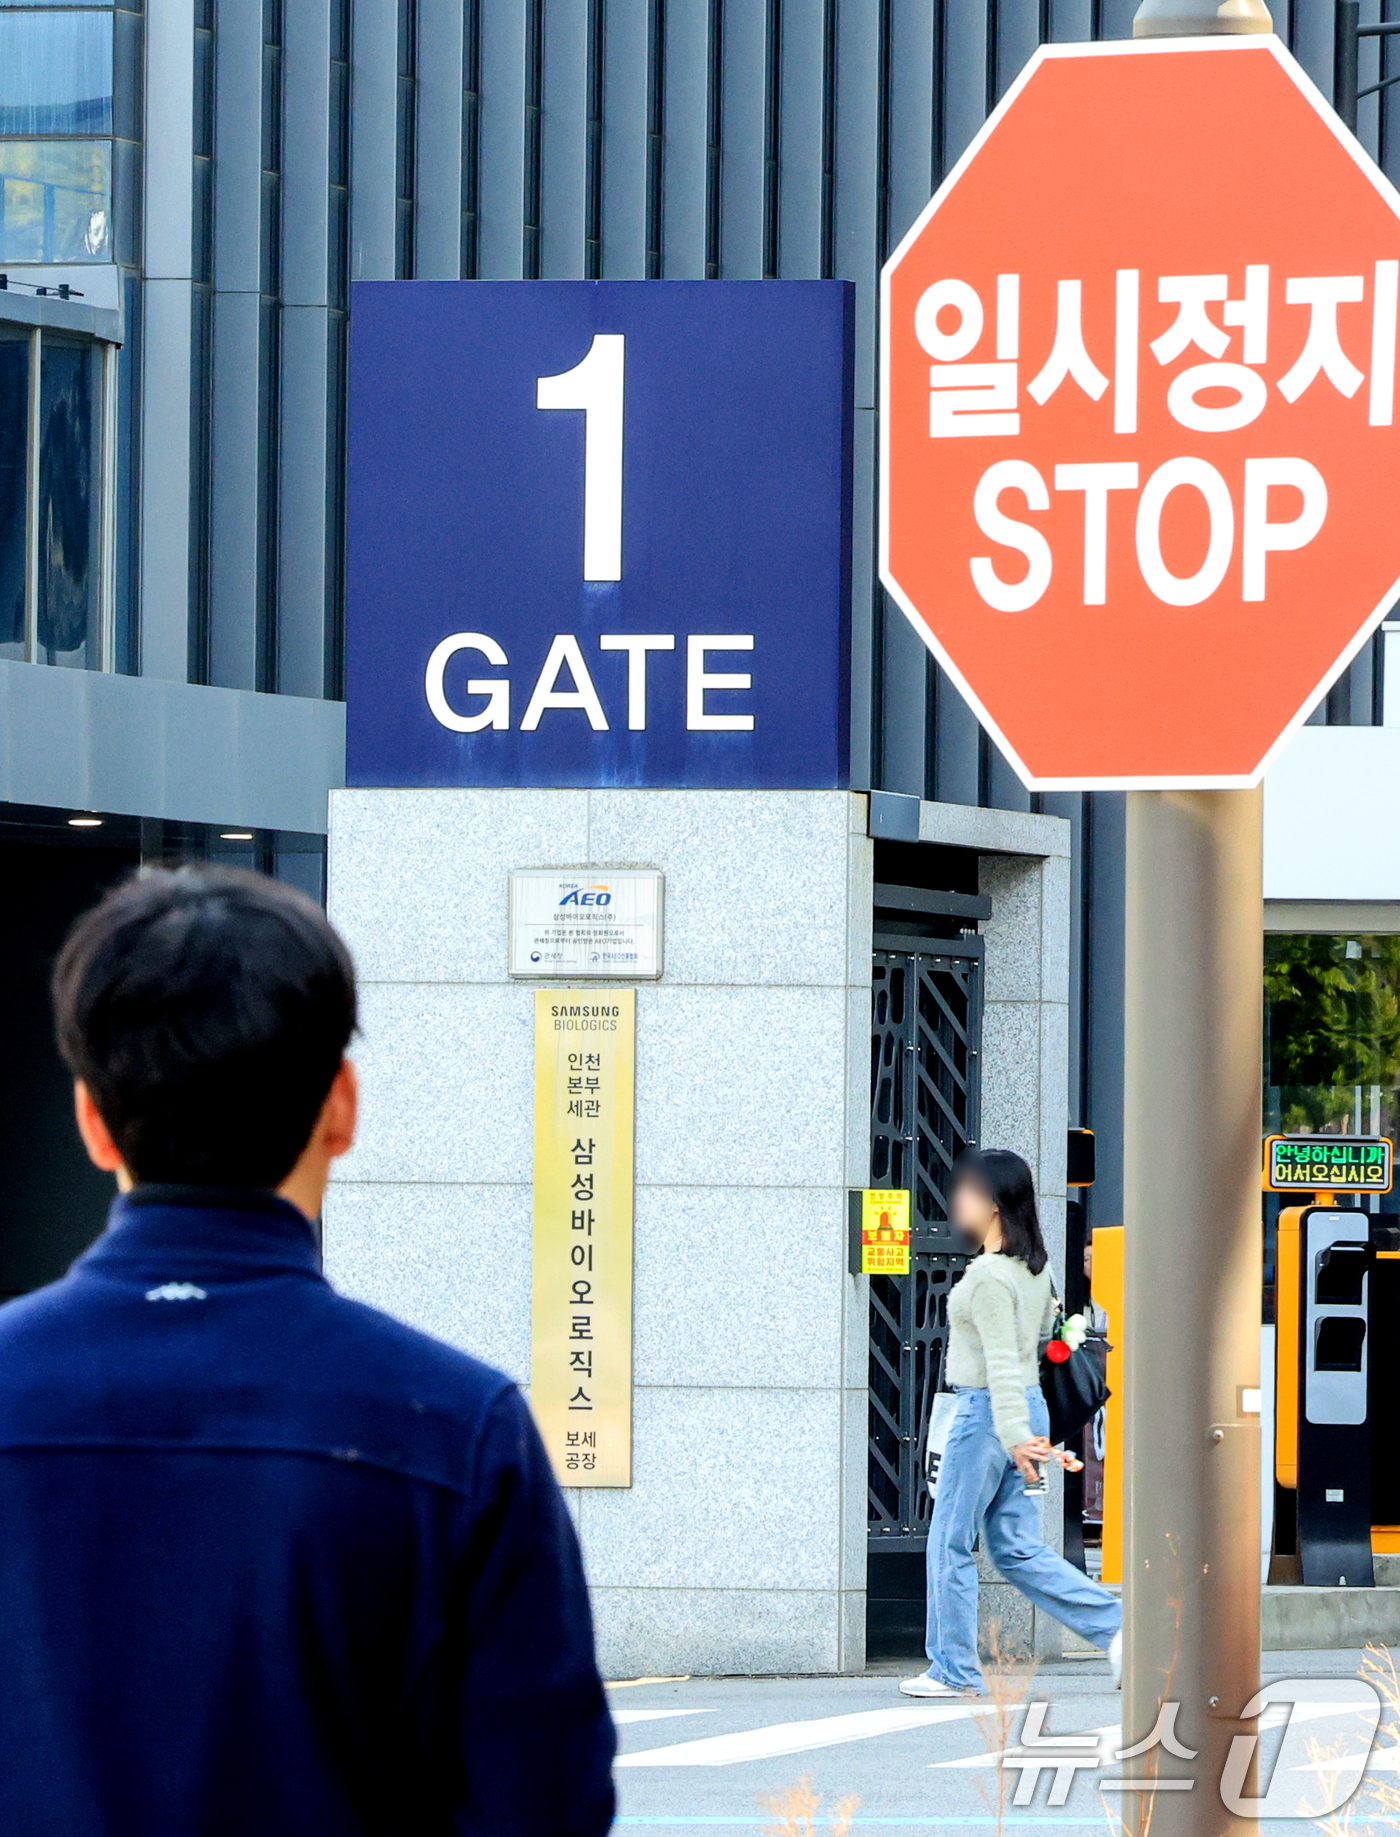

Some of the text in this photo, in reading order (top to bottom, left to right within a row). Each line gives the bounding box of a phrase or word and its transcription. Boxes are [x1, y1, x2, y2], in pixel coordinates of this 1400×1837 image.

[914, 259, 1399, 438] 일시정지
[537, 334, 625, 581] 1
[969, 456, 1328, 612] STOP
[425, 631, 754, 733] GATE
[558, 887, 611, 906] AEO
[553, 913, 616, 921] 삼성바이오로직스(주)
[551, 1005, 620, 1018] SAMSUNG
[554, 1019, 617, 1031] BIOLOGICS
[567, 1053, 601, 1071] 인천
[567, 1076, 601, 1095] 본부
[567, 1099, 601, 1118] 세관
[1276, 1144, 1385, 1164] 안녕하십니까
[1275, 1164, 1384, 1183] 어서오십시오
[867, 1257, 904, 1267] 위험지역
[568, 1138, 596, 1410] 삼성바이오로직스
[565, 1431, 596, 1448] 보세
[565, 1453, 596, 1470] 공장
